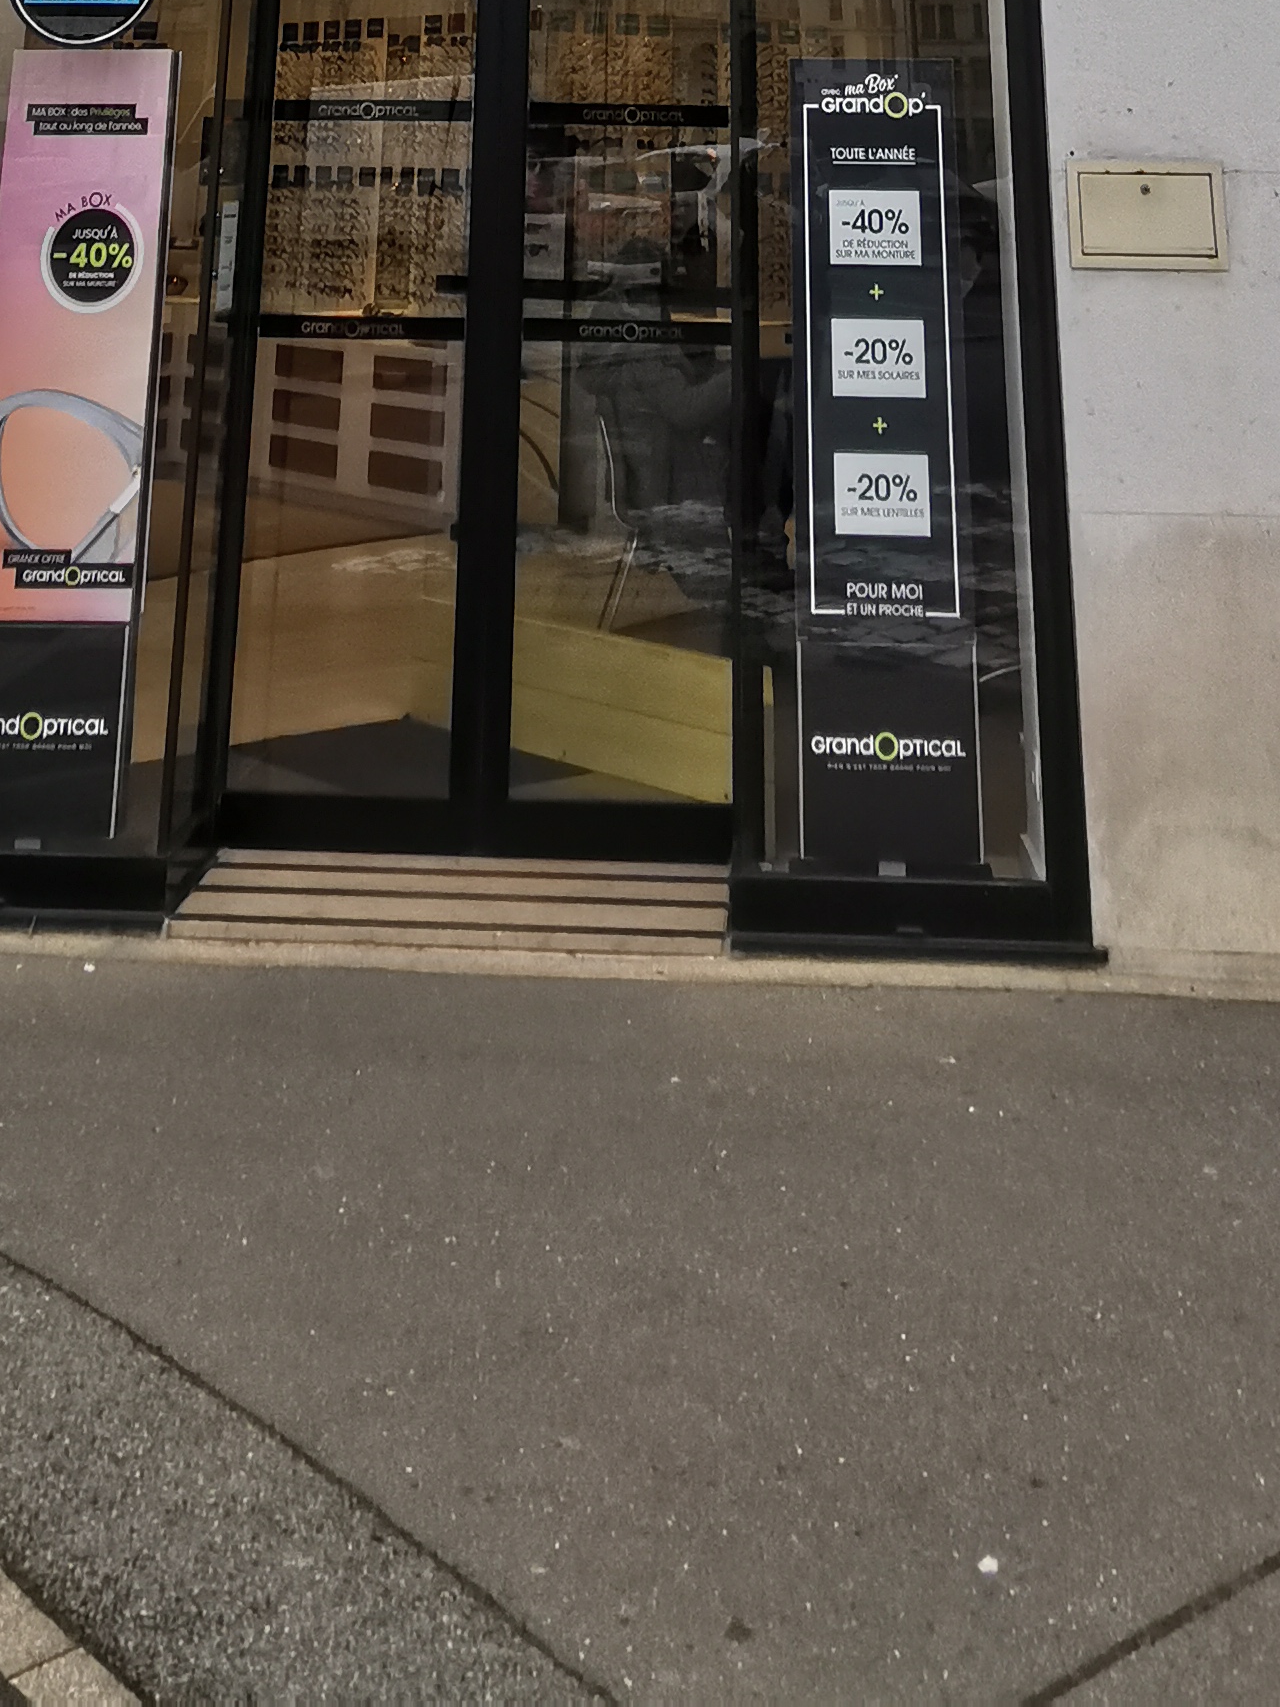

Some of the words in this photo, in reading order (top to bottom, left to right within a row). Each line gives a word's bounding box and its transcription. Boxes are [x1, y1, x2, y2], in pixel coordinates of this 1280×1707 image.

[844, 83, 865, 96] ma
[72, 121, 93, 134] long
[95, 121, 108, 131] de
[830, 147, 867, 160] TOUTE
[868, 144, 916, 161] L'ANNÉE
[54, 202, 76, 223] MA
[81, 191, 113, 209] BOX
[841, 208, 910, 235] -40%
[842, 238, 855, 248] DE
[856, 237, 909, 250] RÉDUCTION
[52, 242, 133, 269] -40%
[835, 249, 853, 259] SUR
[854, 249, 870, 259] MA
[872, 249, 916, 260] MONTURE
[843, 338, 914, 366] -20%
[837, 370, 855, 380] SUR
[856, 370, 877, 380] MES
[846, 473, 918, 502] -20%
[846, 582, 888, 600] POUR
[891, 583, 924, 601] MOI
[846, 603, 859, 617] ET
[860, 603, 877, 617] UN
[878, 603, 924, 618] PROCHE
